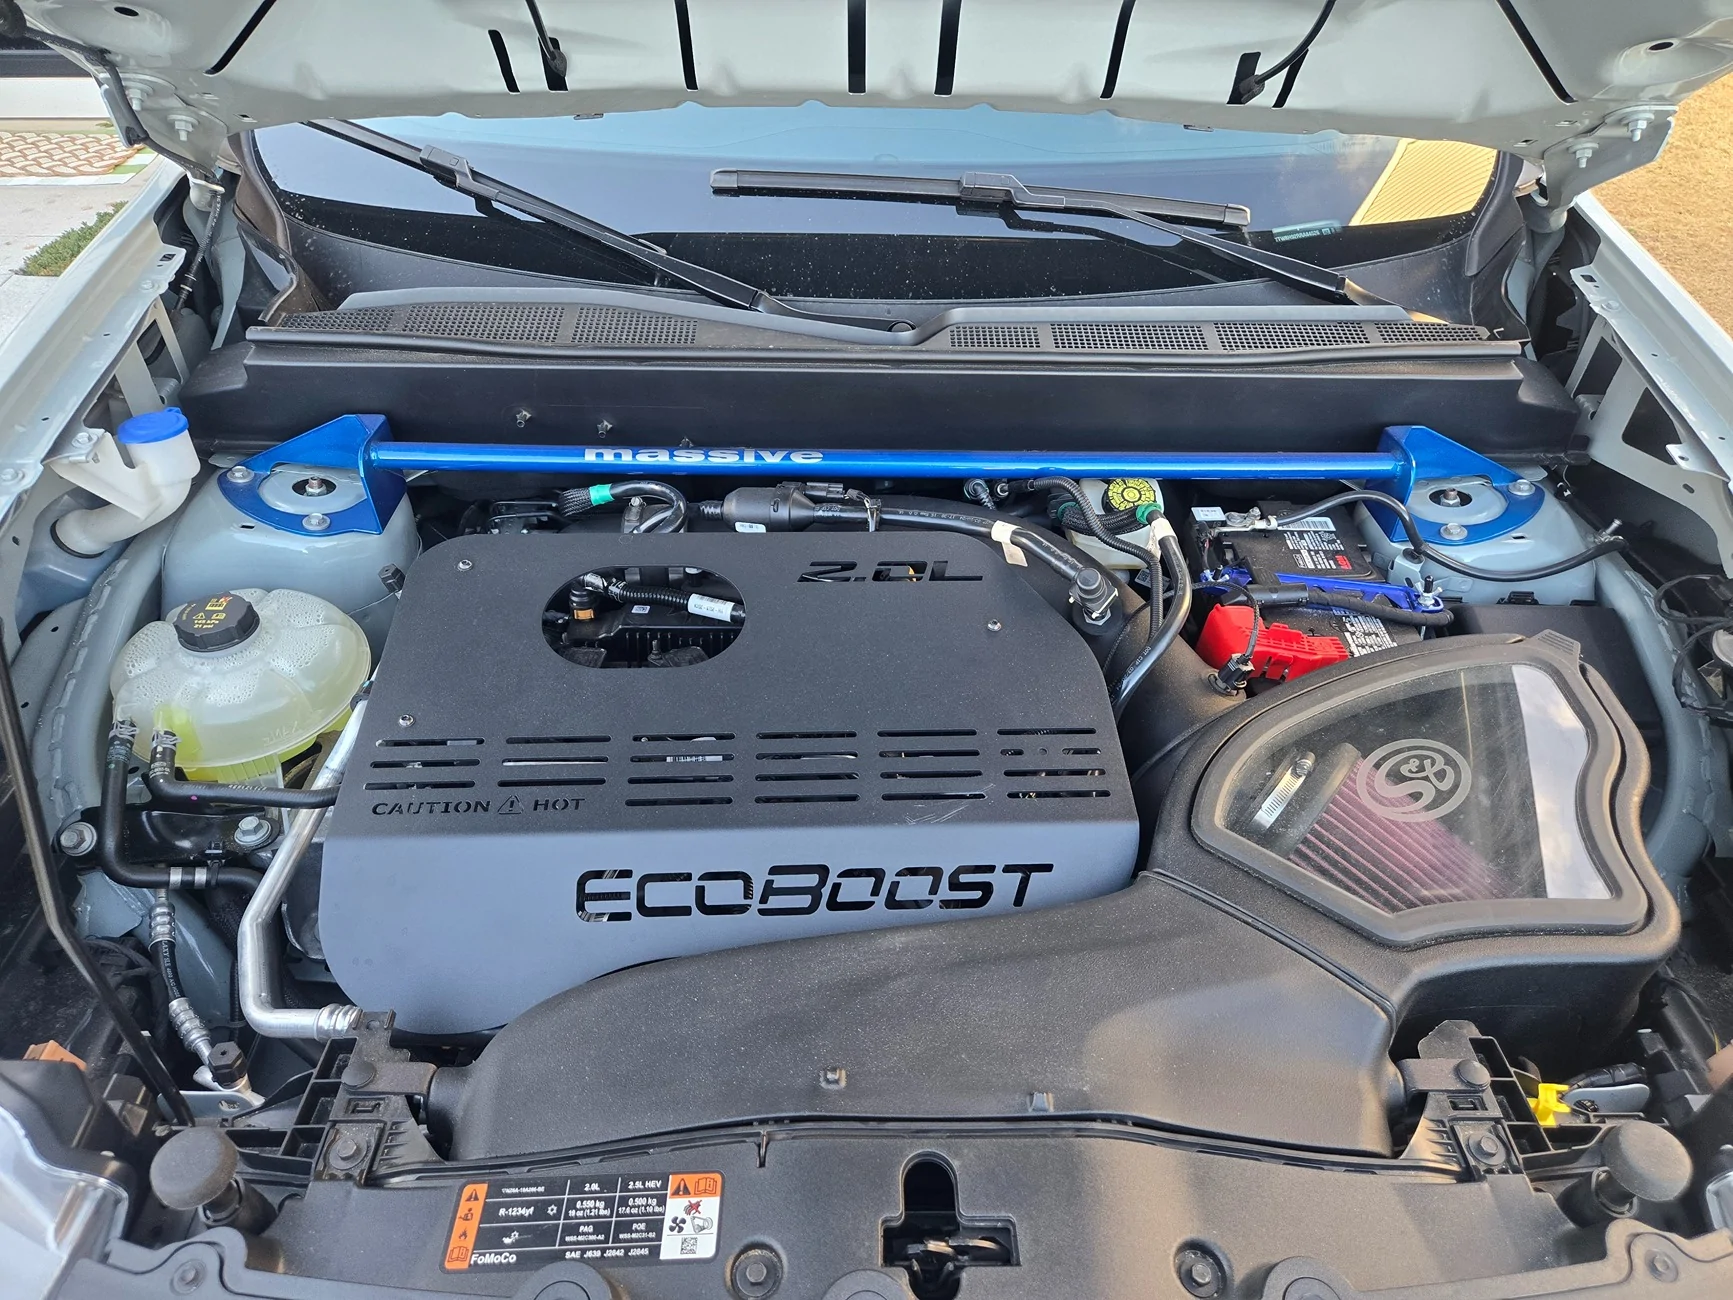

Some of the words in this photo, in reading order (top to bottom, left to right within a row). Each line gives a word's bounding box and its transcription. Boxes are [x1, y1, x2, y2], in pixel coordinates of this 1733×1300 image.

[584, 448, 823, 463] massive
[797, 560, 983, 582] 2.0L
[371, 800, 491, 815] CAUTION
[532, 798, 586, 812] HOT
[584, 1183, 600, 1192] 2.0L
[628, 1181, 644, 1189] 2.5L
[645, 1180, 662, 1188] HEV
[576, 1200, 595, 1209] 0.550
[595, 1200, 605, 1209] kg
[628, 1197, 647, 1206] 0.500
[647, 1197, 657, 1206] kg
[498, 1206, 535, 1217] R-1234yf
[579, 1225, 594, 1233] PAG
[632, 1222, 646, 1231] POE
[565, 1251, 581, 1259] SAE
[583, 1249, 601, 1258] J639
[470, 1252, 517, 1266] FoMoCo
